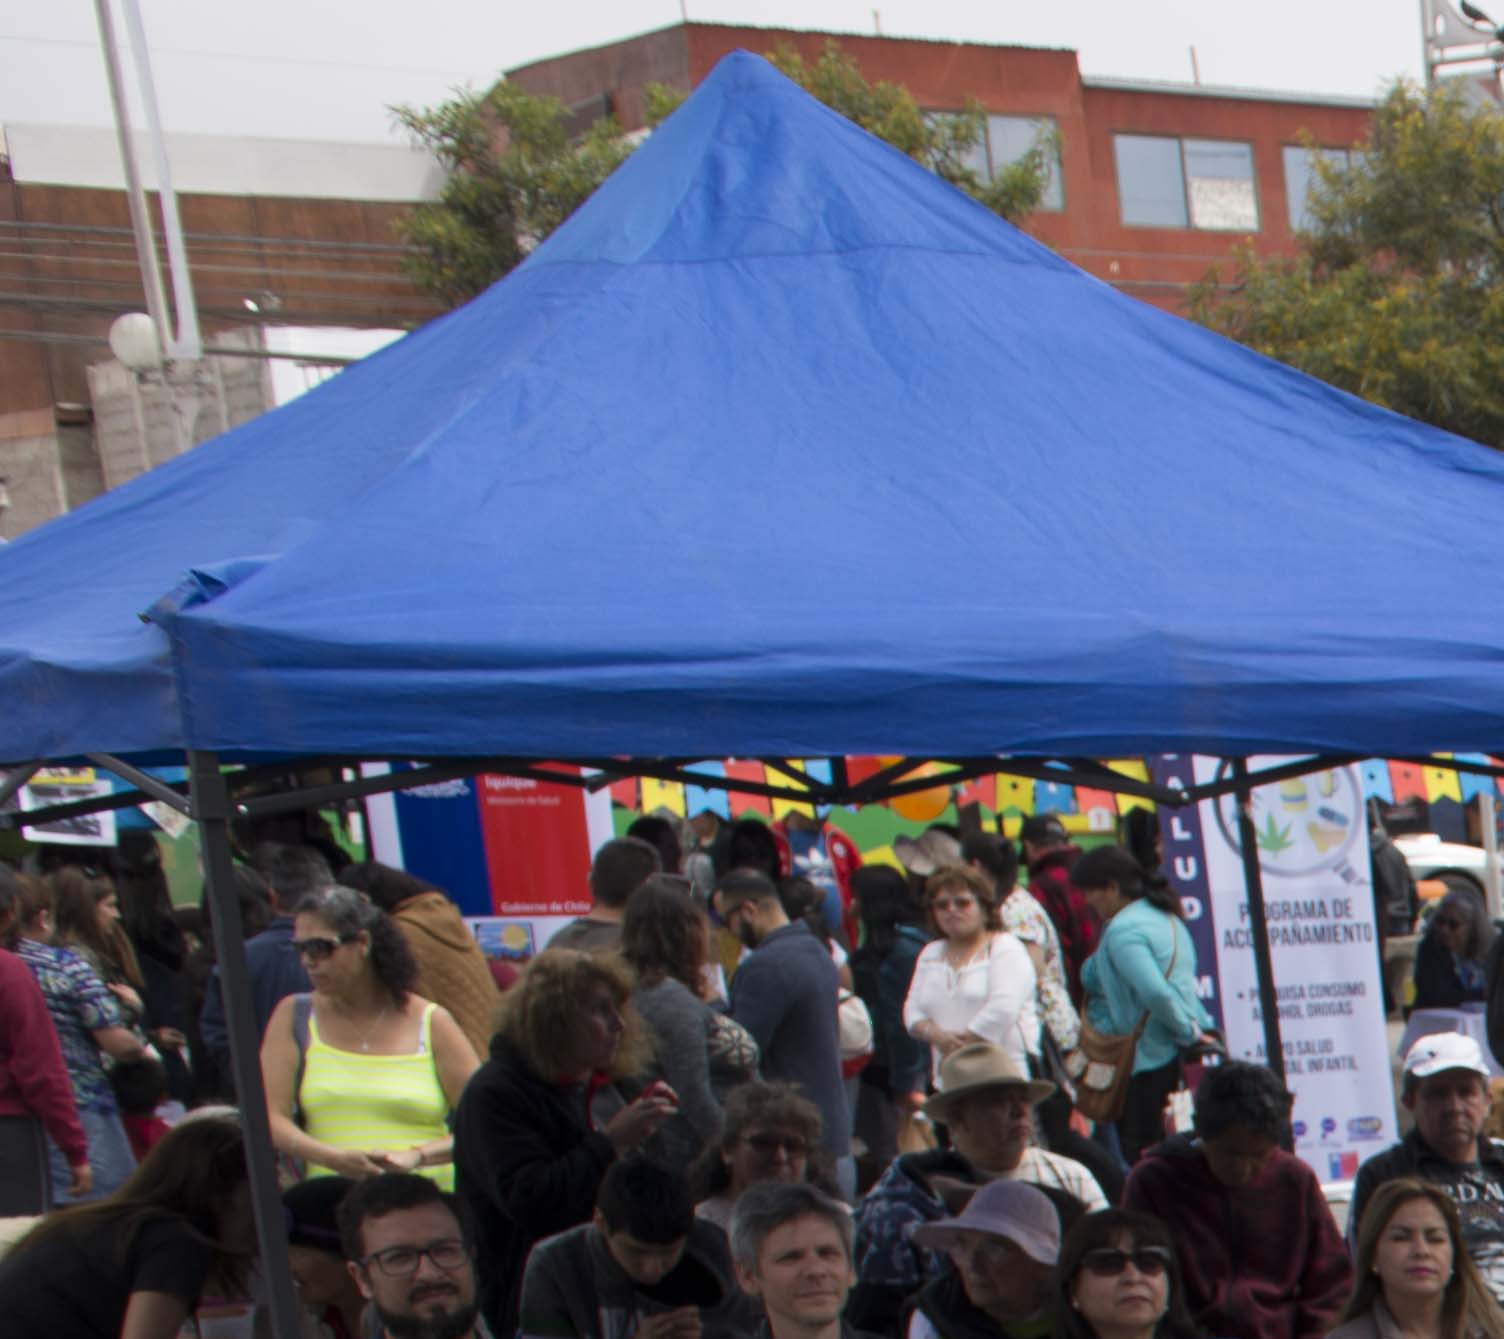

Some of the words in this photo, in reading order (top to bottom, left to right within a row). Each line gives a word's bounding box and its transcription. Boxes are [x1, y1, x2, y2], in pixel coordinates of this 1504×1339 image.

[1239, 899, 1328, 922] POGRAMA
[1331, 898, 1353, 917] DE
[1223, 921, 1372, 948] ACOPAÑAMIENTO
